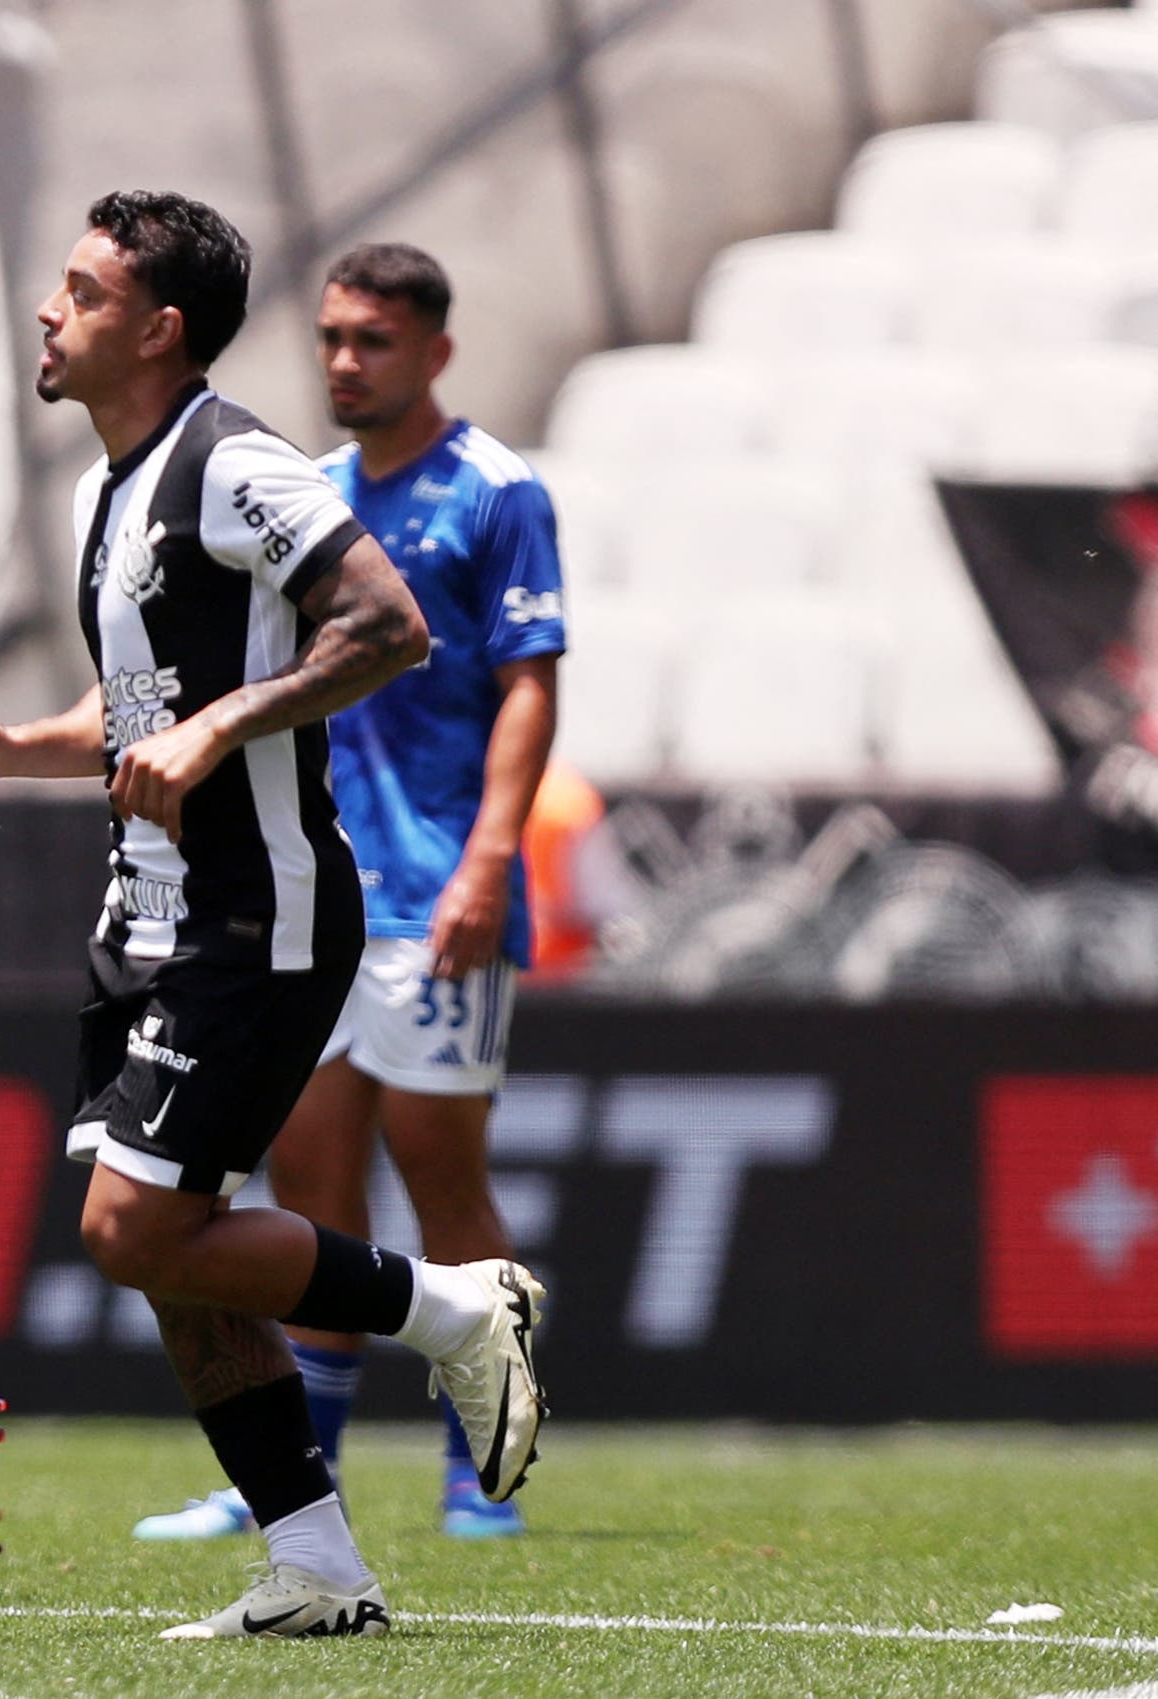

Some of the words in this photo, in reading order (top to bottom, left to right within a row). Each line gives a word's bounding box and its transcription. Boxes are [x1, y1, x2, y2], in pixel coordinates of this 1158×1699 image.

[102, 666, 182, 710] ortes
[103, 704, 177, 750] Sorte
[121, 875, 189, 920] XLUX
[412, 974, 466, 1029] 33
